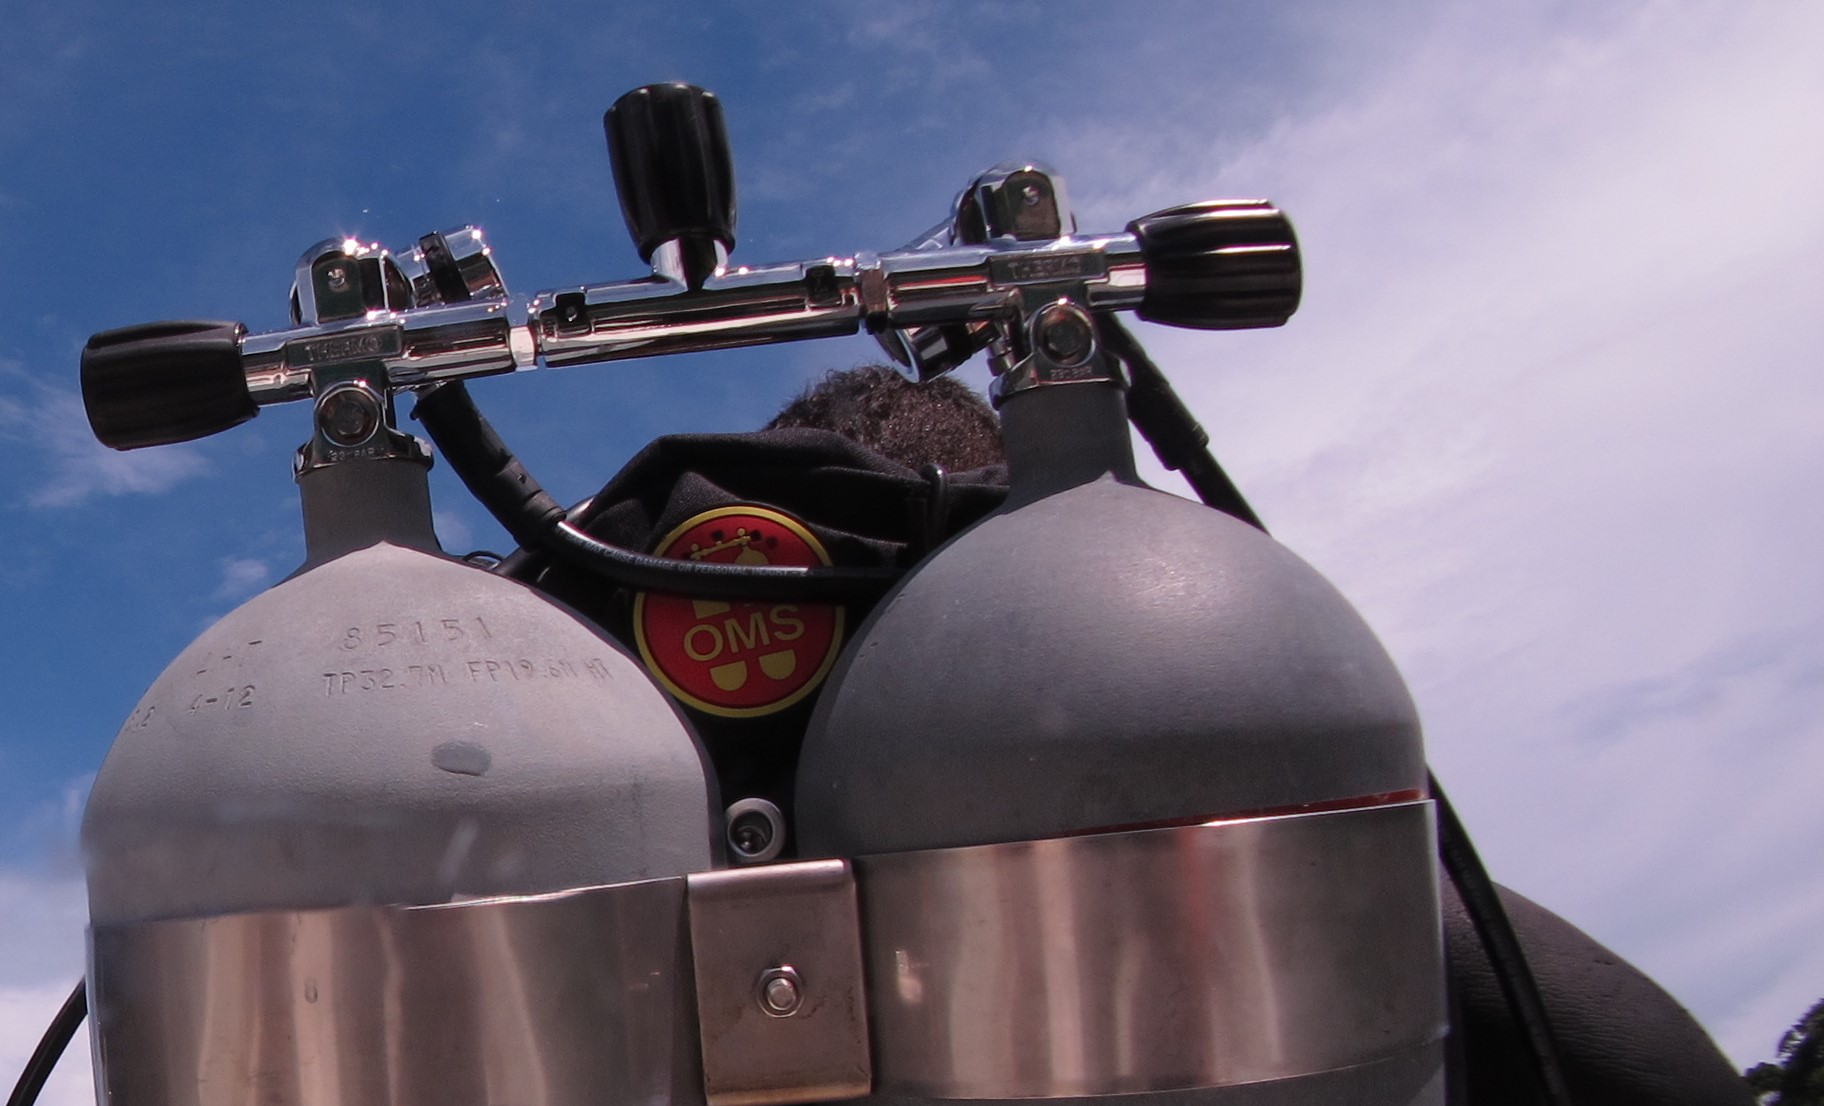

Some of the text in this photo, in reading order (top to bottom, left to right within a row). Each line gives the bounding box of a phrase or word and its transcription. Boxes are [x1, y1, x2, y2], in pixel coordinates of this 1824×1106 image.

[695, 564, 750, 576] PERSONAL
[342, 616, 493, 650] 85151
[683, 604, 806, 663] OMS
